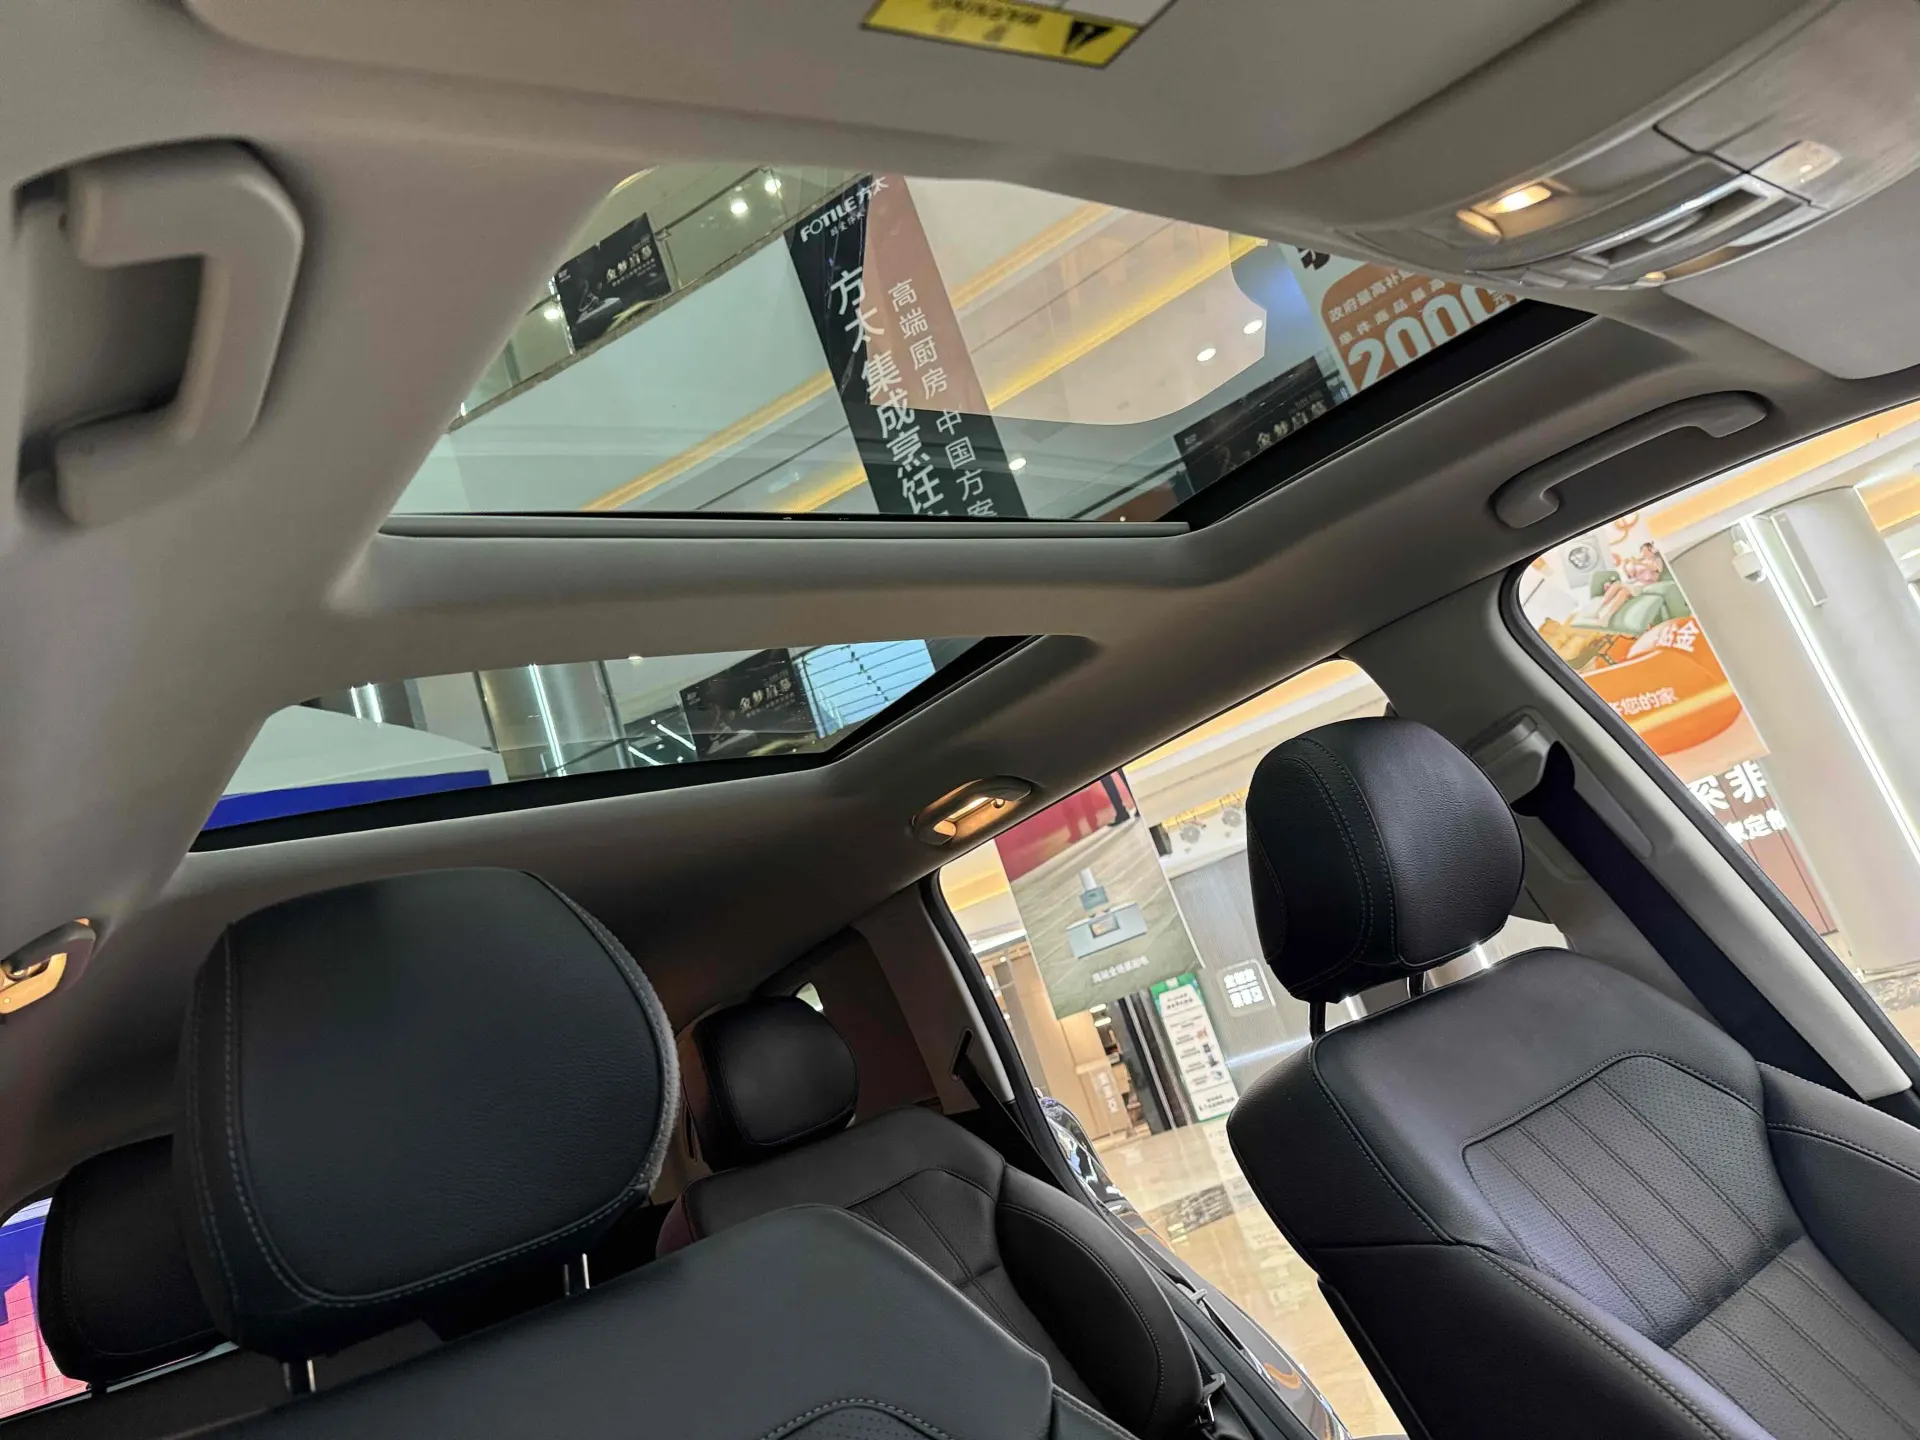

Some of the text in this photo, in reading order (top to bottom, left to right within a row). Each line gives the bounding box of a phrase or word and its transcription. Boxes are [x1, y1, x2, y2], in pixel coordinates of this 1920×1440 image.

[800, 176, 890, 243] FOTILE 方太
[830, 266, 949, 516] 方太集成烹饪
